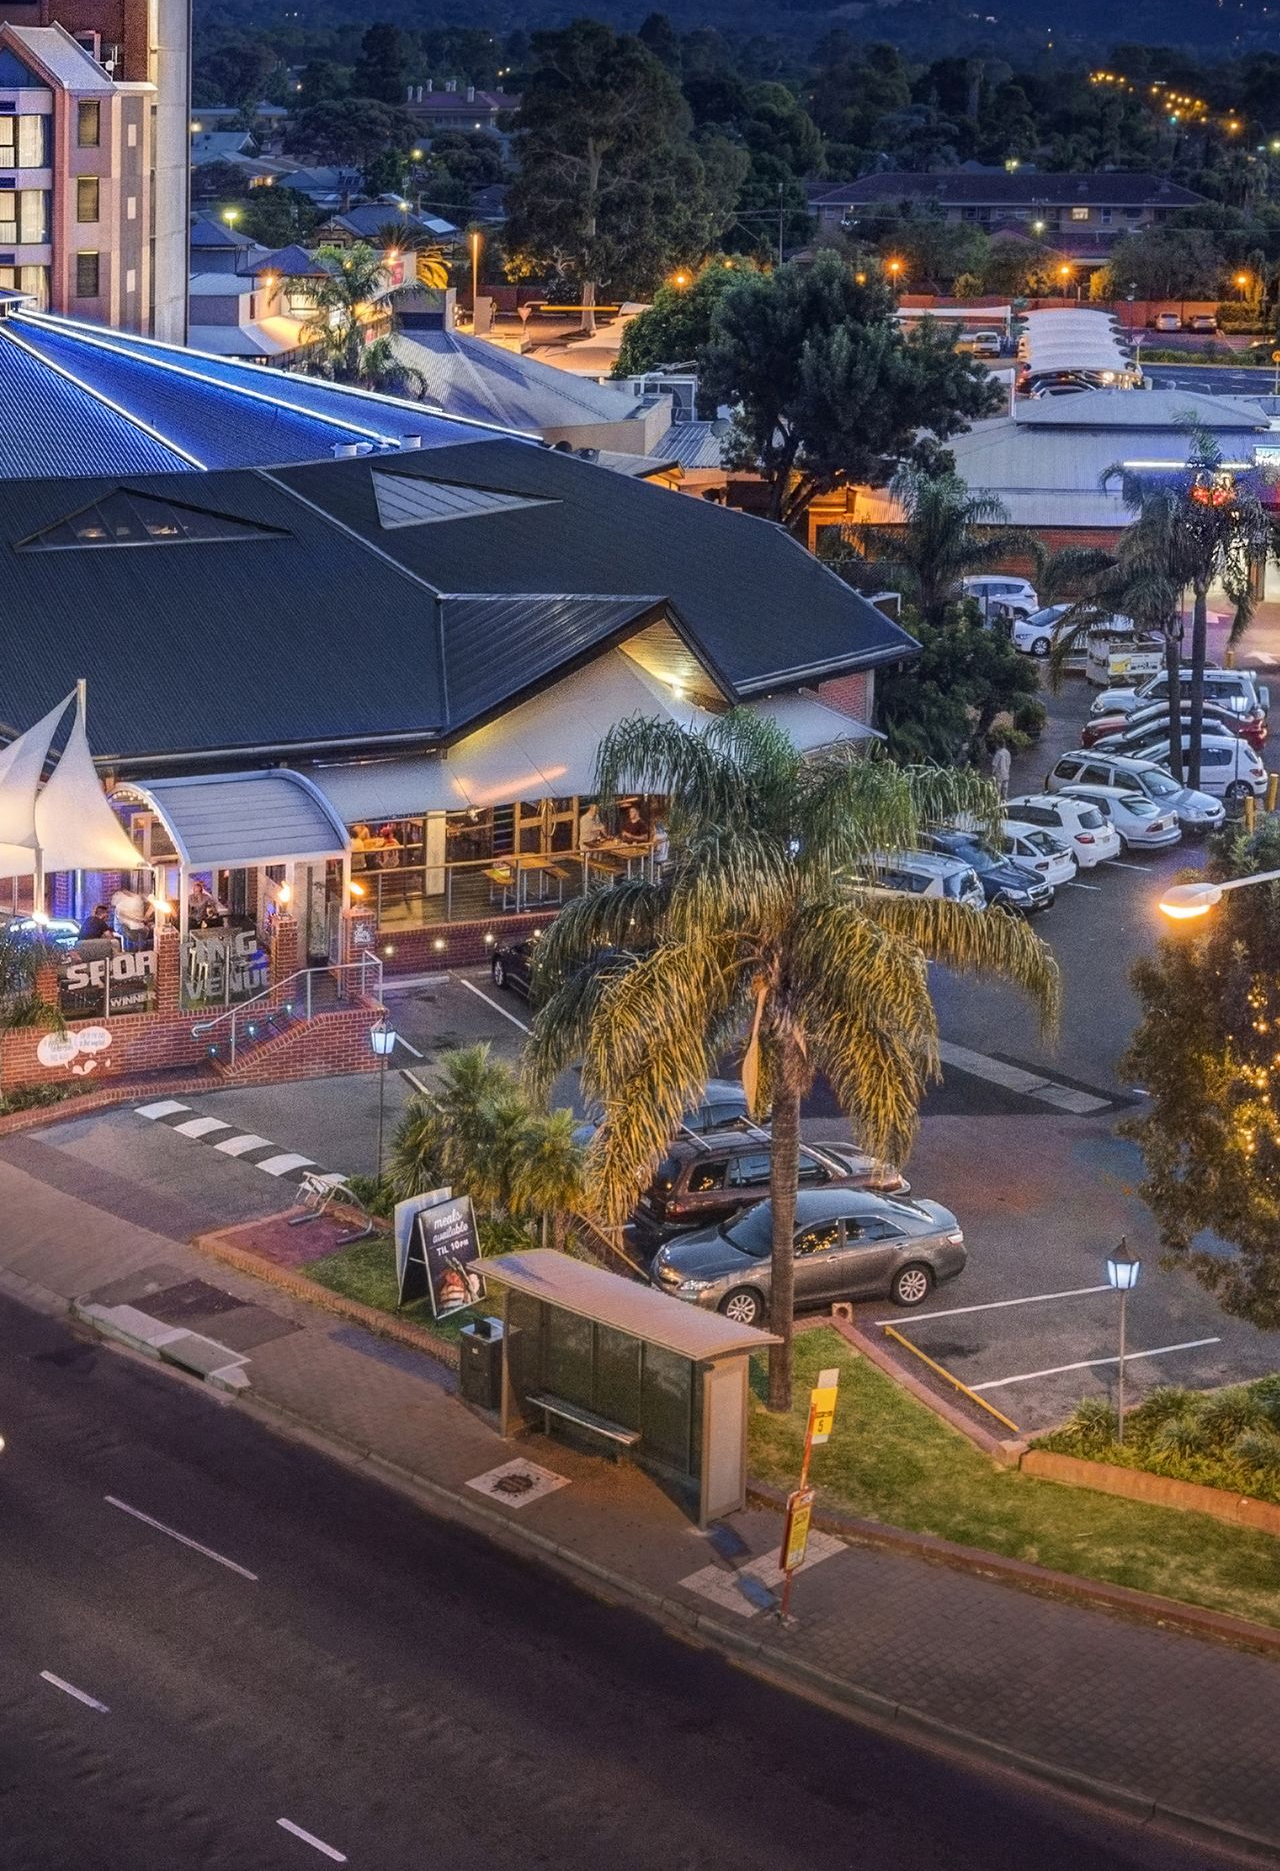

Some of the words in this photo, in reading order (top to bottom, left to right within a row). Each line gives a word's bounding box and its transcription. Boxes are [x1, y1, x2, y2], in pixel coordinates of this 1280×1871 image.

[111, 991, 157, 1008] WINNER
[434, 1208, 463, 1230] meals
[432, 1222, 468, 1243] available
[436, 1246, 449, 1256] TIL
